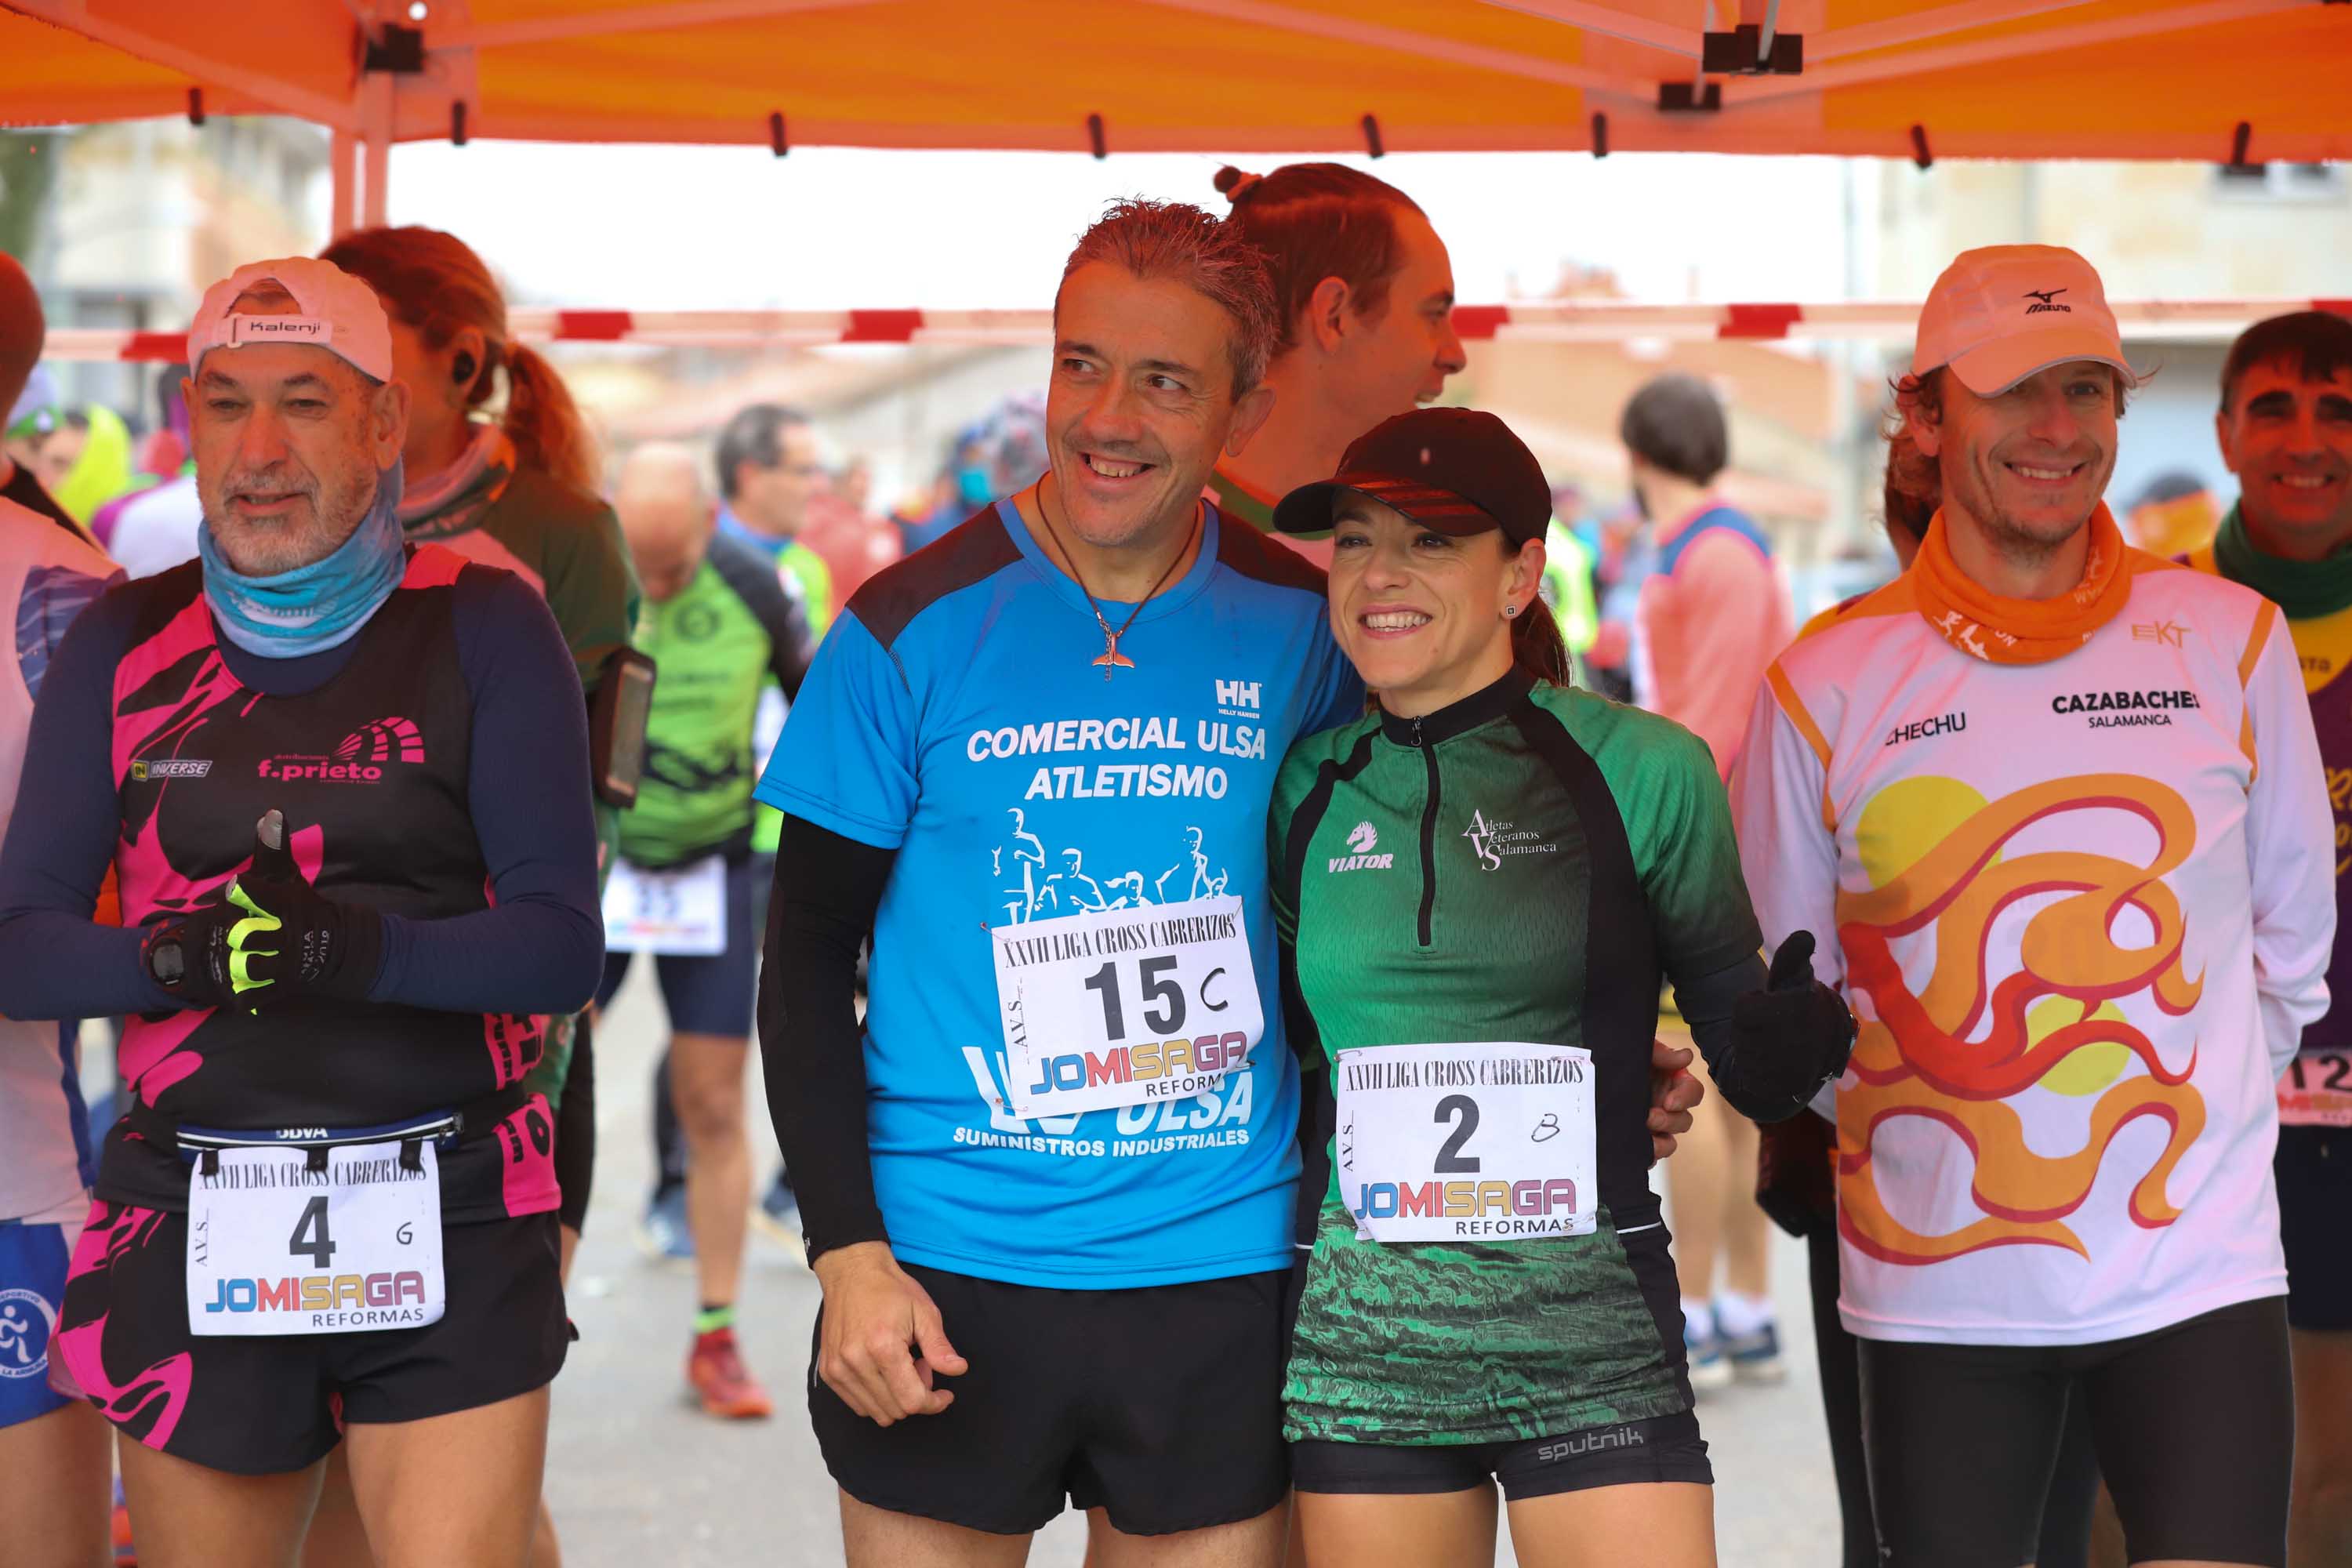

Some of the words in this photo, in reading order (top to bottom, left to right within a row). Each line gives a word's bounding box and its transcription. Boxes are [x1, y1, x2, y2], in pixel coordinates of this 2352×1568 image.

[2026, 303, 2071, 314] MIZUNO
[251, 322, 321, 335] Kalenji
[2132, 621, 2190, 648] EKT
[1215, 679, 1260, 709] HH
[2089, 714, 2172, 728] SALAMANCA
[967, 717, 1186, 763] COMERCIAL
[1198, 720, 1265, 760] ULSA
[152, 763, 208, 775] INVERSE
[258, 759, 382, 782] f.prieto
[1024, 764, 1229, 800] ATLETISMO
[1461, 808, 1513, 837] Atletas
[1468, 830, 1540, 859] Veteranos
[1482, 842, 1557, 871] Salamanca
[1329, 853, 1394, 873] VIATOR
[1004, 936, 1050, 968] XXVII
[1053, 931, 1091, 961] LIGA
[1095, 923, 1147, 955] CROSS
[1149, 913, 1236, 948] CABRERIZOS
[1084, 955, 1186, 1041] 15
[1200, 967, 1229, 1011] C
[1029, 1031, 1247, 1095] JOMISAGA
[1346, 1062, 1382, 1091] XXVII
[1386, 1061, 1420, 1088] LIGA
[1425, 1059, 1475, 1087] CROSS
[1480, 1058, 1584, 1087] CABRERIZOS
[953, 1127, 1105, 1156] SUMINISTROS
[1112, 1129, 1250, 1157] INDUSTRIALES
[1434, 1094, 1480, 1174] 2
[245, 1162, 276, 1189] LIGA
[1355, 1178, 1577, 1219] JOMISAGA
[289, 1196, 336, 1269] 4
[1455, 1218, 1574, 1235] REFORMAS
[205, 1271, 426, 1312] JOMISAGA
[313, 1308, 424, 1327] REFORMAS
[1538, 1427, 1644, 1461] sputnik
